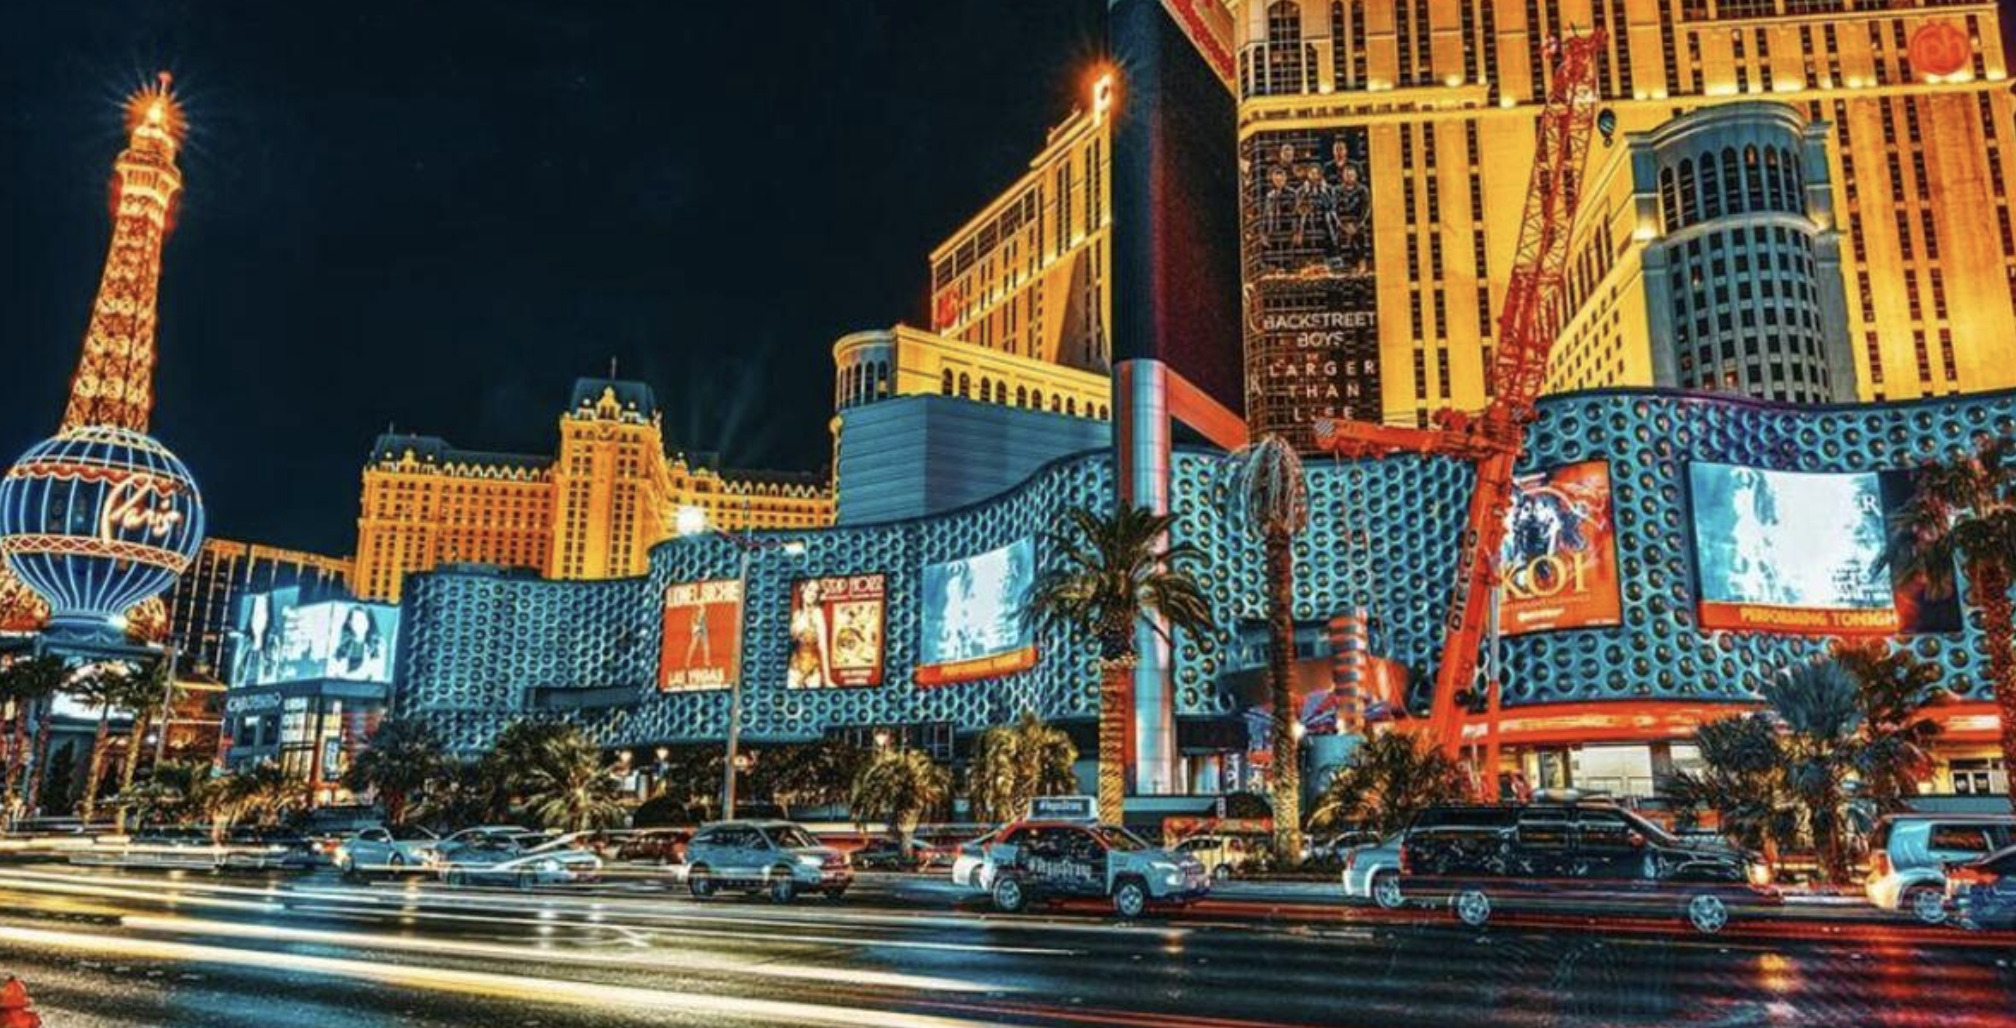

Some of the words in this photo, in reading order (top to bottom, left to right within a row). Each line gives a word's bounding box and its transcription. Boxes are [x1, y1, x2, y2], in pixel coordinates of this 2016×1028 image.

[1263, 311, 1375, 329] BACKSTREET
[1297, 332, 1344, 348] BOYS
[1268, 360, 1376, 378] LARGER
[1288, 383, 1360, 398] THAN
[101, 473, 181, 545] Paris
